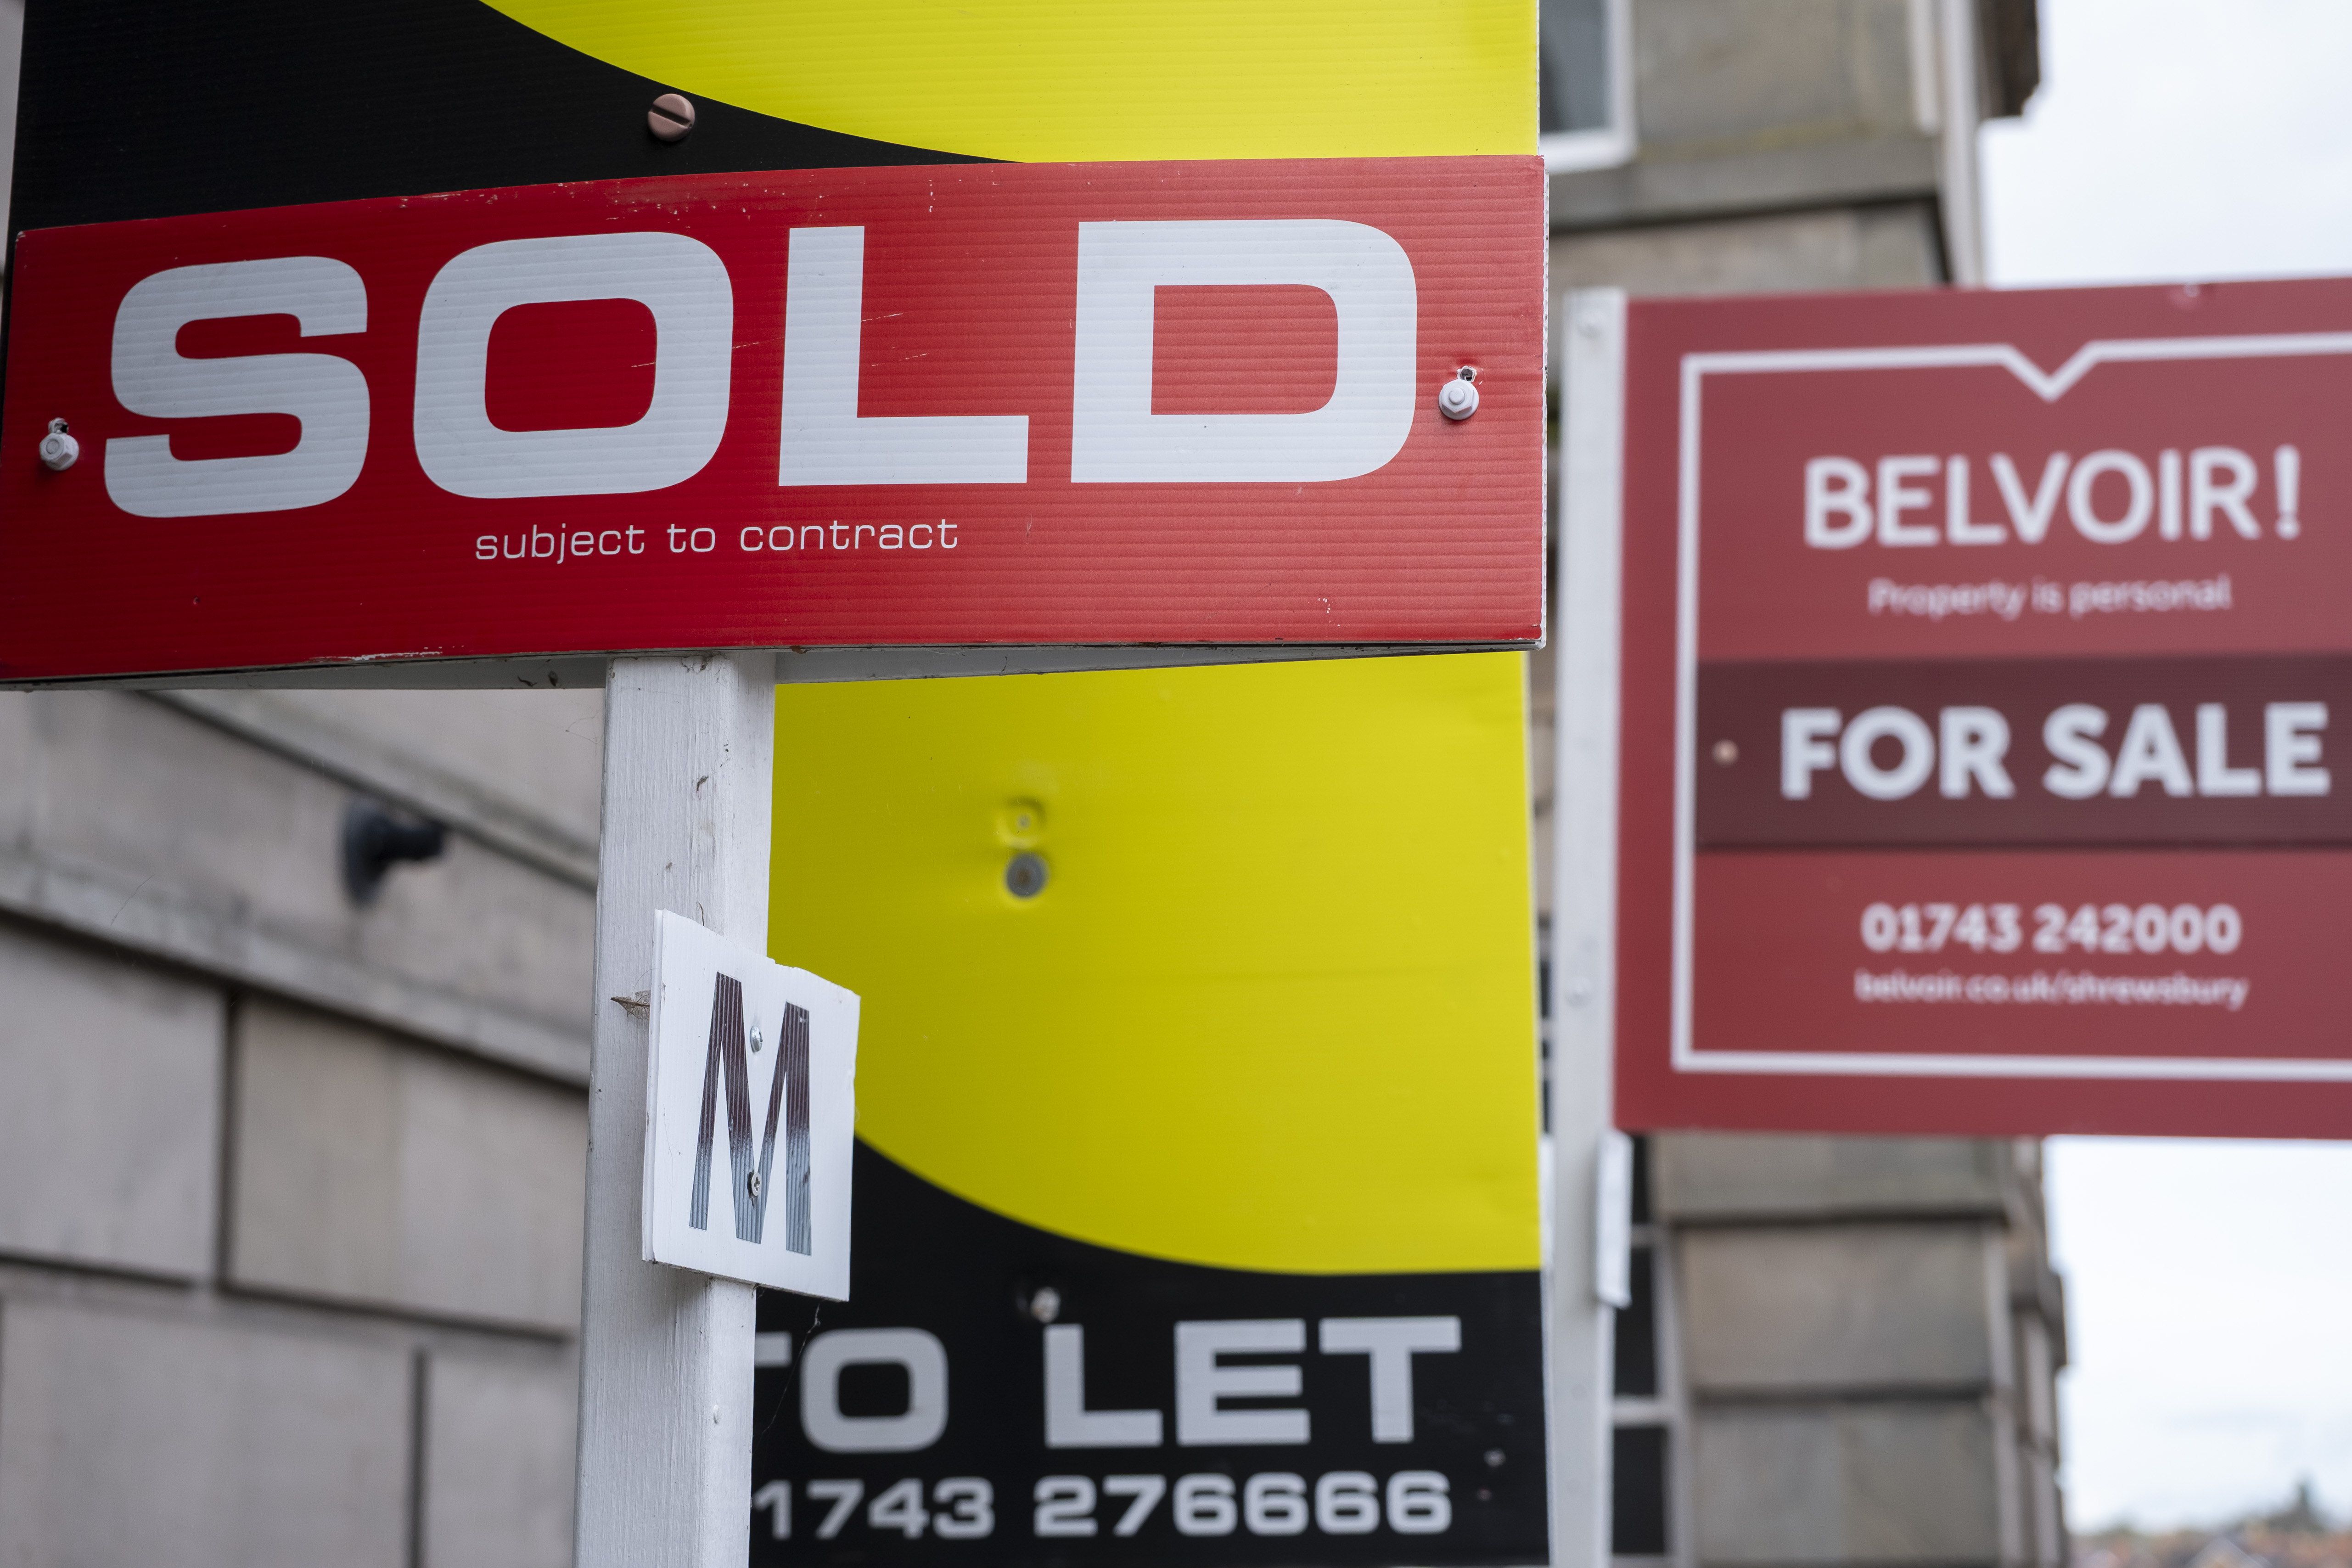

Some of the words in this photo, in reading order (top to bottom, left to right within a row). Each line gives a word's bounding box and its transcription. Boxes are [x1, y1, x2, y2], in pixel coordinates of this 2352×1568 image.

[105, 219, 1418, 517] SOLD
[476, 523, 645, 564] subject
[667, 523, 716, 553] to
[740, 518, 958, 551] contract
[1804, 445, 2301, 548] BELVOIR!
[1867, 577, 2027, 621] Property
[2032, 576, 2065, 613] is
[2068, 573, 2232, 619] personal
[1781, 706, 2014, 799] FOR
[2043, 703, 2331, 798] SALE
[1860, 903, 2022, 953] 01743
[2032, 903, 2242, 954] 242000
[689, 971, 812, 1256] M
[755, 1328, 948, 1453] O
[1044, 1315, 1462, 1447] LET
[1034, 1470, 1452, 1536] 276666
